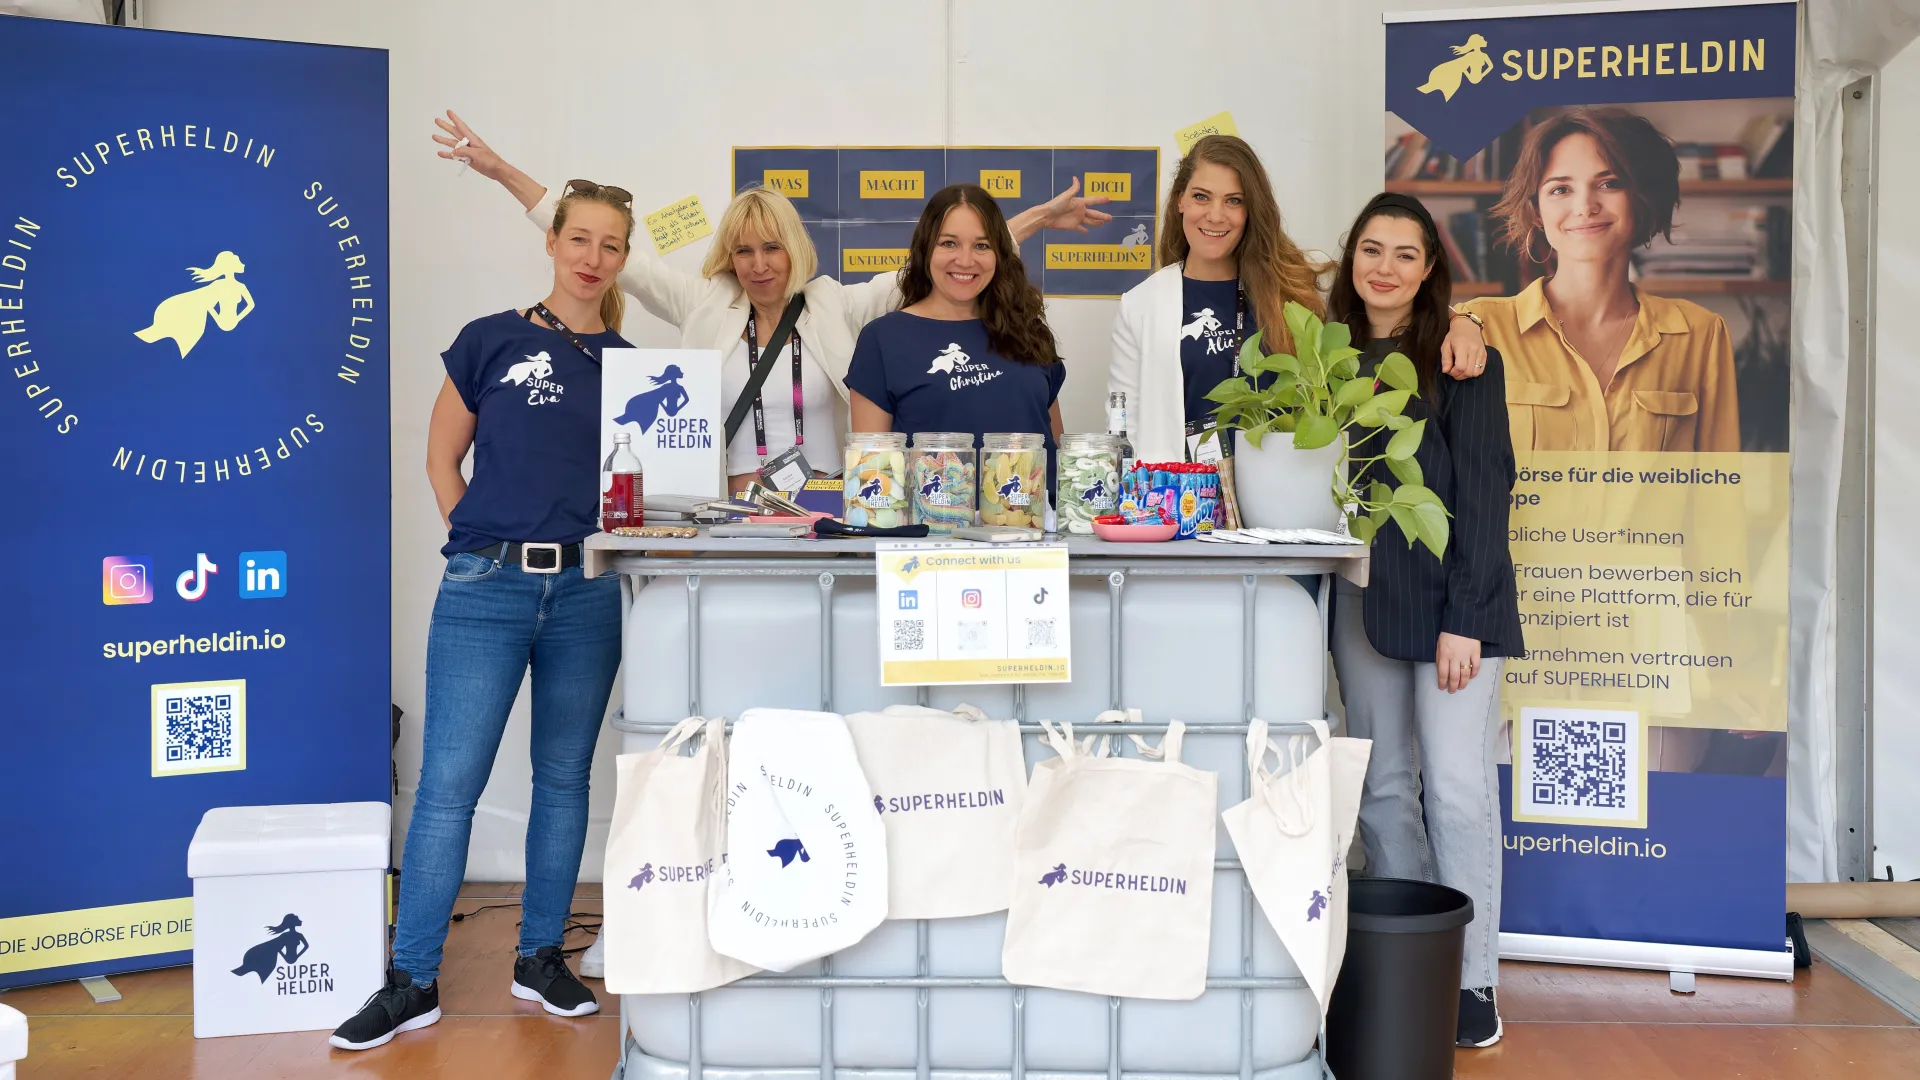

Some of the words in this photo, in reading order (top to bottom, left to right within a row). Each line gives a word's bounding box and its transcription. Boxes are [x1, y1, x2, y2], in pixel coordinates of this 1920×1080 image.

[1501, 38, 1766, 82] SUPERHELDIN
[56, 125, 276, 188] SUPERHELDIN
[770, 178, 803, 191] WAS
[866, 179, 919, 191] MACHT
[987, 176, 1015, 191] FÜR
[1090, 180, 1125, 193] DICH
[1051, 250, 1147, 265] SUPERHELDIN?
[303, 181, 374, 385] SUPERHELDIN
[0, 216, 79, 434] SUPERHELDIN
[1206, 336, 1235, 356] Alic
[954, 363, 990, 373] SUPER
[526, 377, 564, 395] SUPER
[949, 370, 1004, 391] Christina
[527, 389, 561, 406] Eva
[656, 418, 708, 433] SUPER
[112, 413, 325, 483] SUPERHELDIN
[657, 434, 712, 449] HELDIN
[1568, 467, 1598, 483] für
[1602, 467, 1634, 484] die
[1638, 467, 1742, 485] weibliche
[926, 555, 976, 567] Connect
[980, 555, 1005, 565] with
[1007, 556, 1021, 565] us
[1513, 563, 1583, 580] Frauen
[1589, 564, 1694, 582] bewerben
[1699, 567, 1743, 584] sich
[1533, 586, 1575, 603] eine
[1580, 588, 1681, 608] Plattform,
[1685, 590, 1718, 608] die
[1723, 591, 1753, 609] für
[1518, 610, 1601, 631] onzipiert
[1607, 611, 1630, 628] ist
[103, 629, 286, 664] superheldin.io
[1508, 647, 1625, 664] ernehmen
[1630, 651, 1734, 668] vertrauen
[1505, 669, 1539, 685] auf
[1543, 670, 1670, 690] SUPERHELDIN
[888, 788, 1005, 813] SUPERHELDIN
[824, 803, 859, 906] SUPERHELDIN
[1503, 833, 1668, 859] uperheldin.io
[1071, 869, 1187, 896] SUPERHELDIN
[741, 900, 838, 929] SUPERHELDIN
[0, 938, 26, 955] DIE
[31, 927, 125, 951] JOBBÖRSE
[130, 920, 162, 939] FÜR
[167, 918, 193, 934] DIE
[276, 962, 330, 981] SUPER
[277, 978, 334, 996] HELDIN
